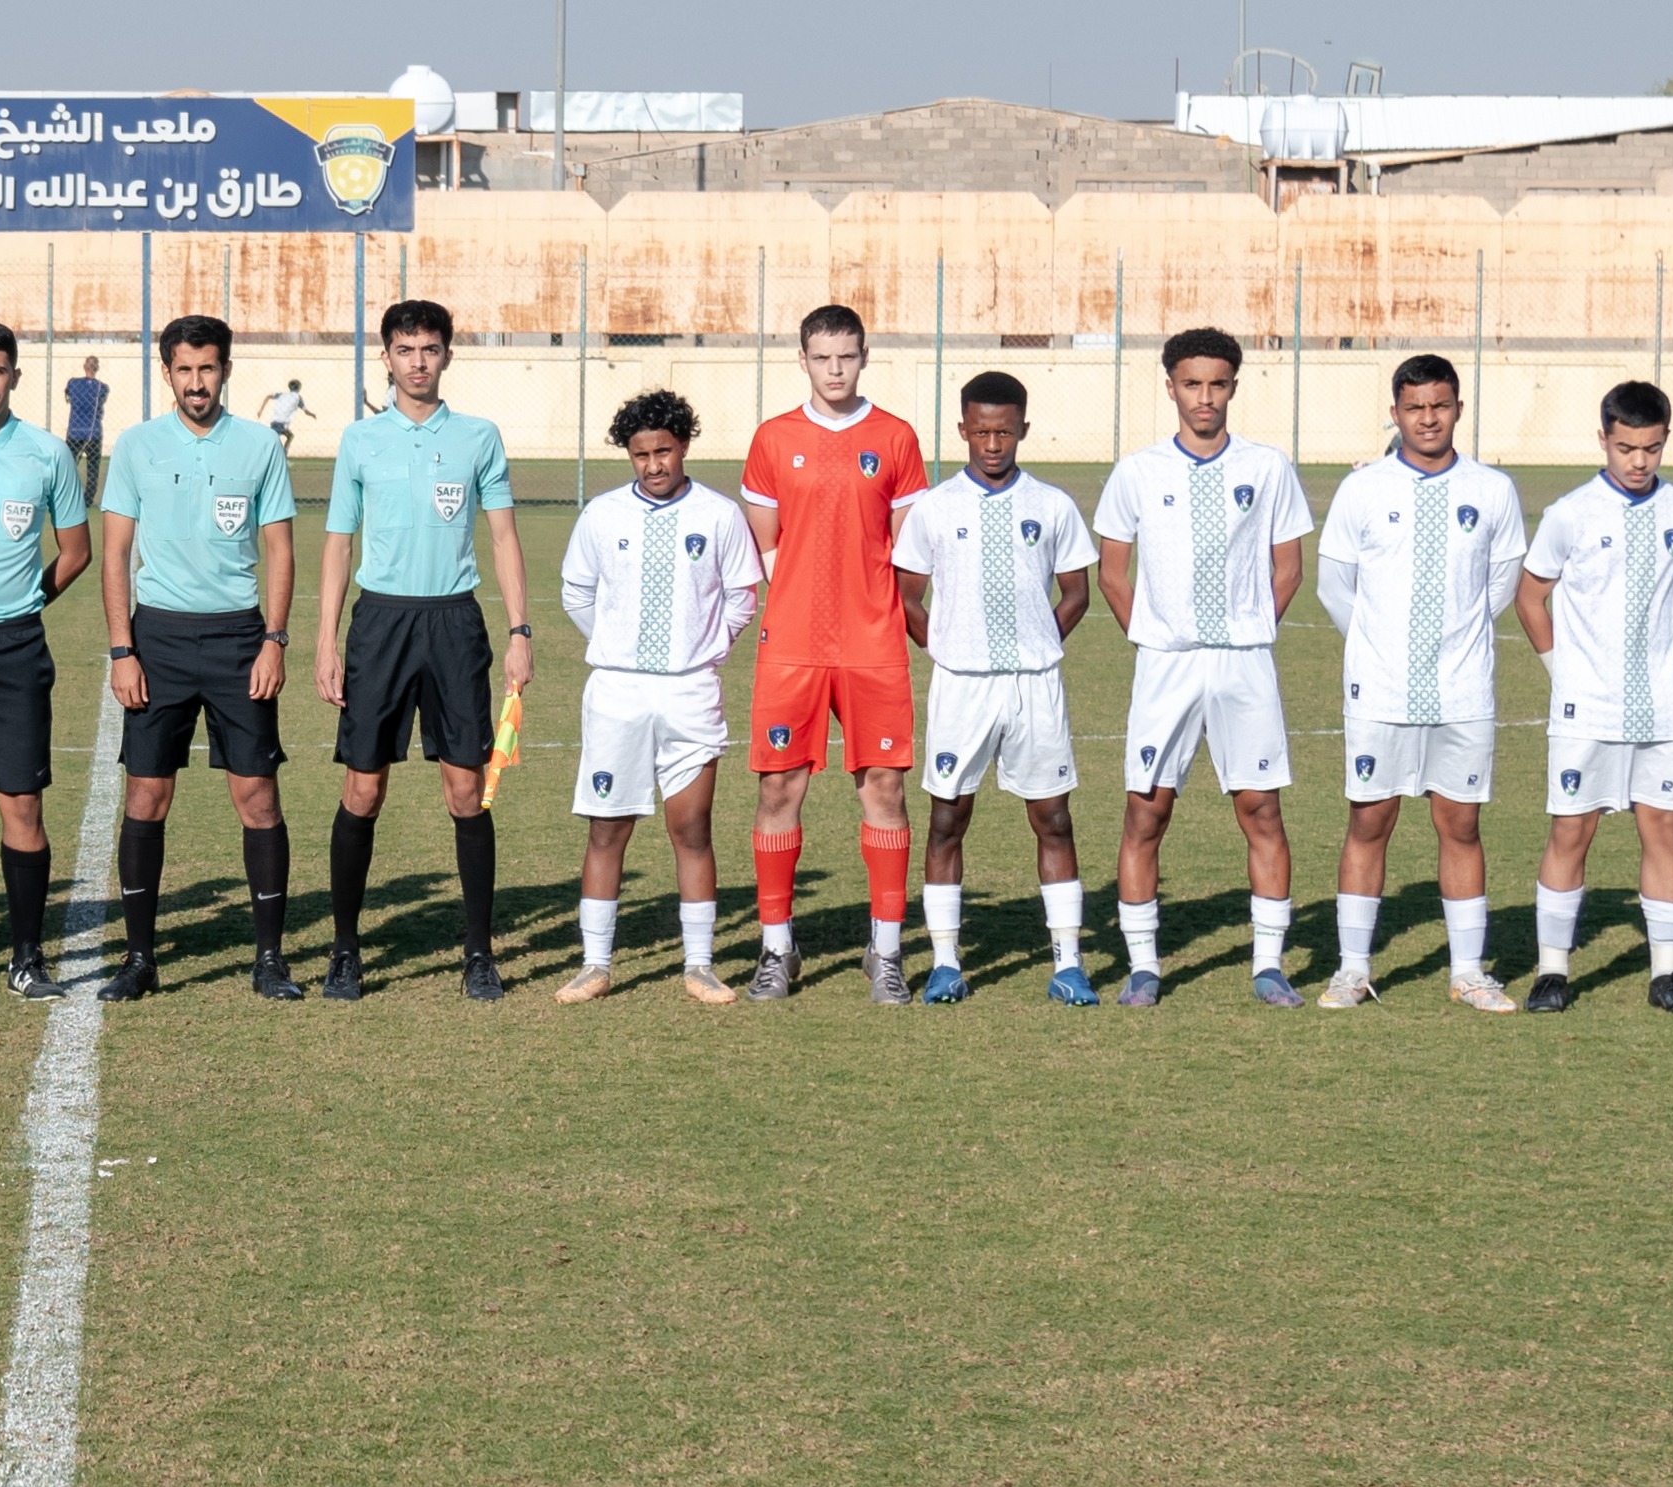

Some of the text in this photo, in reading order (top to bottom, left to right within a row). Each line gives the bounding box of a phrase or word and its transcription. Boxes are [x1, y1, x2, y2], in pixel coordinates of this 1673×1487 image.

[112, 112, 217, 155] ملعب
[26, 174, 149, 220] عبدالله
[155, 176, 198, 218] بن
[206, 168, 302, 217] طارق
[5, 504, 32, 516] SAFF
[217, 500, 245, 511] SAFF
[436, 486, 462, 497] SAFF
